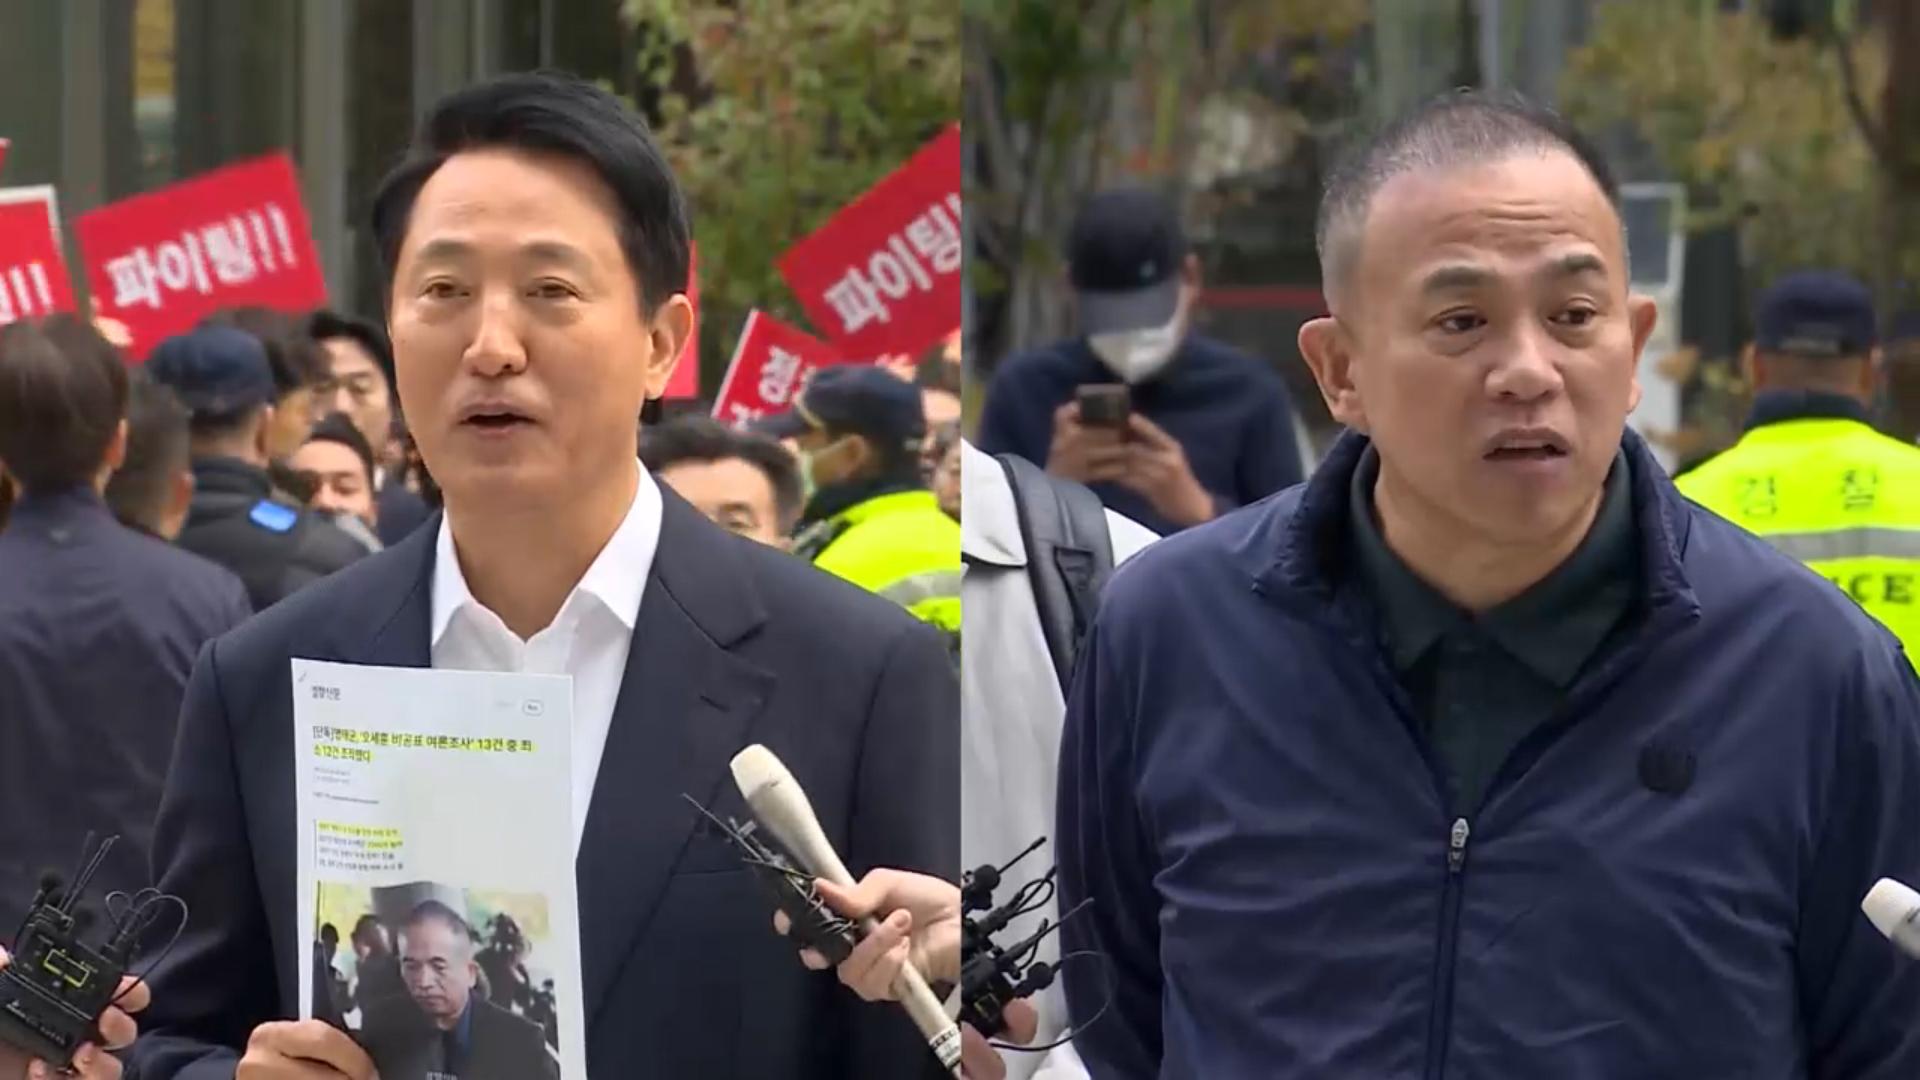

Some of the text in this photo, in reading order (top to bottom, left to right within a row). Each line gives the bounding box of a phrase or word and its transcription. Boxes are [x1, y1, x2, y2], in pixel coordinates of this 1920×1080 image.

[105, 201, 297, 309] 파이팅!!
[1831, 573, 1914, 605] CE
[479, 738, 503, 752] 13건
